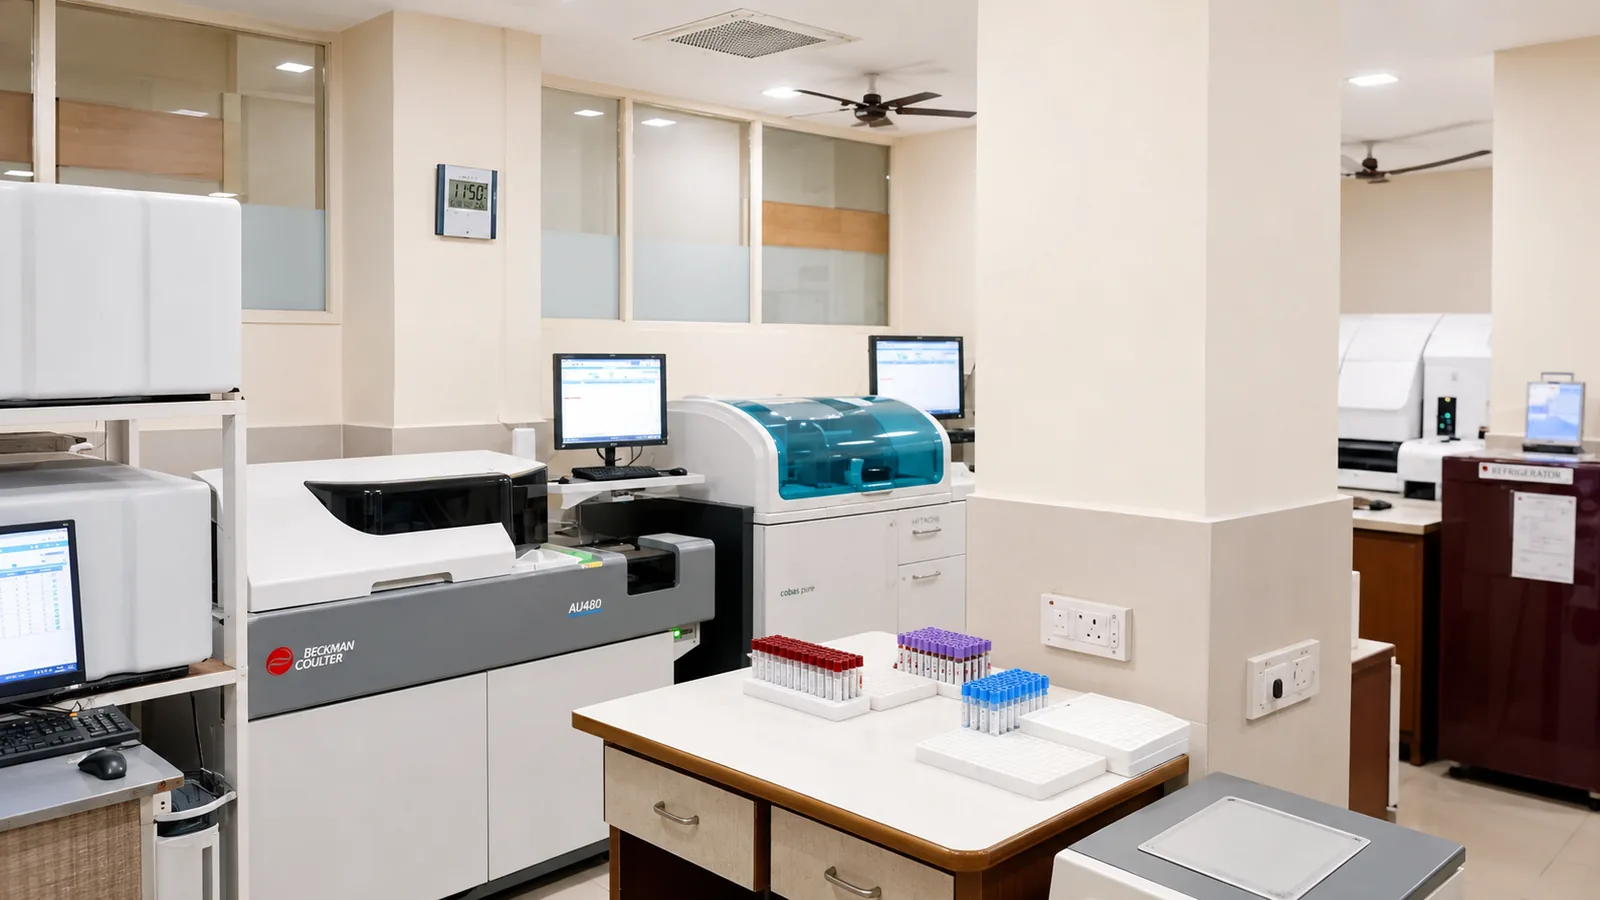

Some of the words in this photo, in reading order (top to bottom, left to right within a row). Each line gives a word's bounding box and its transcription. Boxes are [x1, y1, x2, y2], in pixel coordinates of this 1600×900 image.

[1491, 466, 1562, 480] REFRIGERATOR
[780, 587, 800, 597] cobas
[801, 585, 816, 595] pure
[568, 598, 602, 614] AU480
[303, 640, 355, 659] BECKMAN
[295, 653, 343, 671] COULTER
